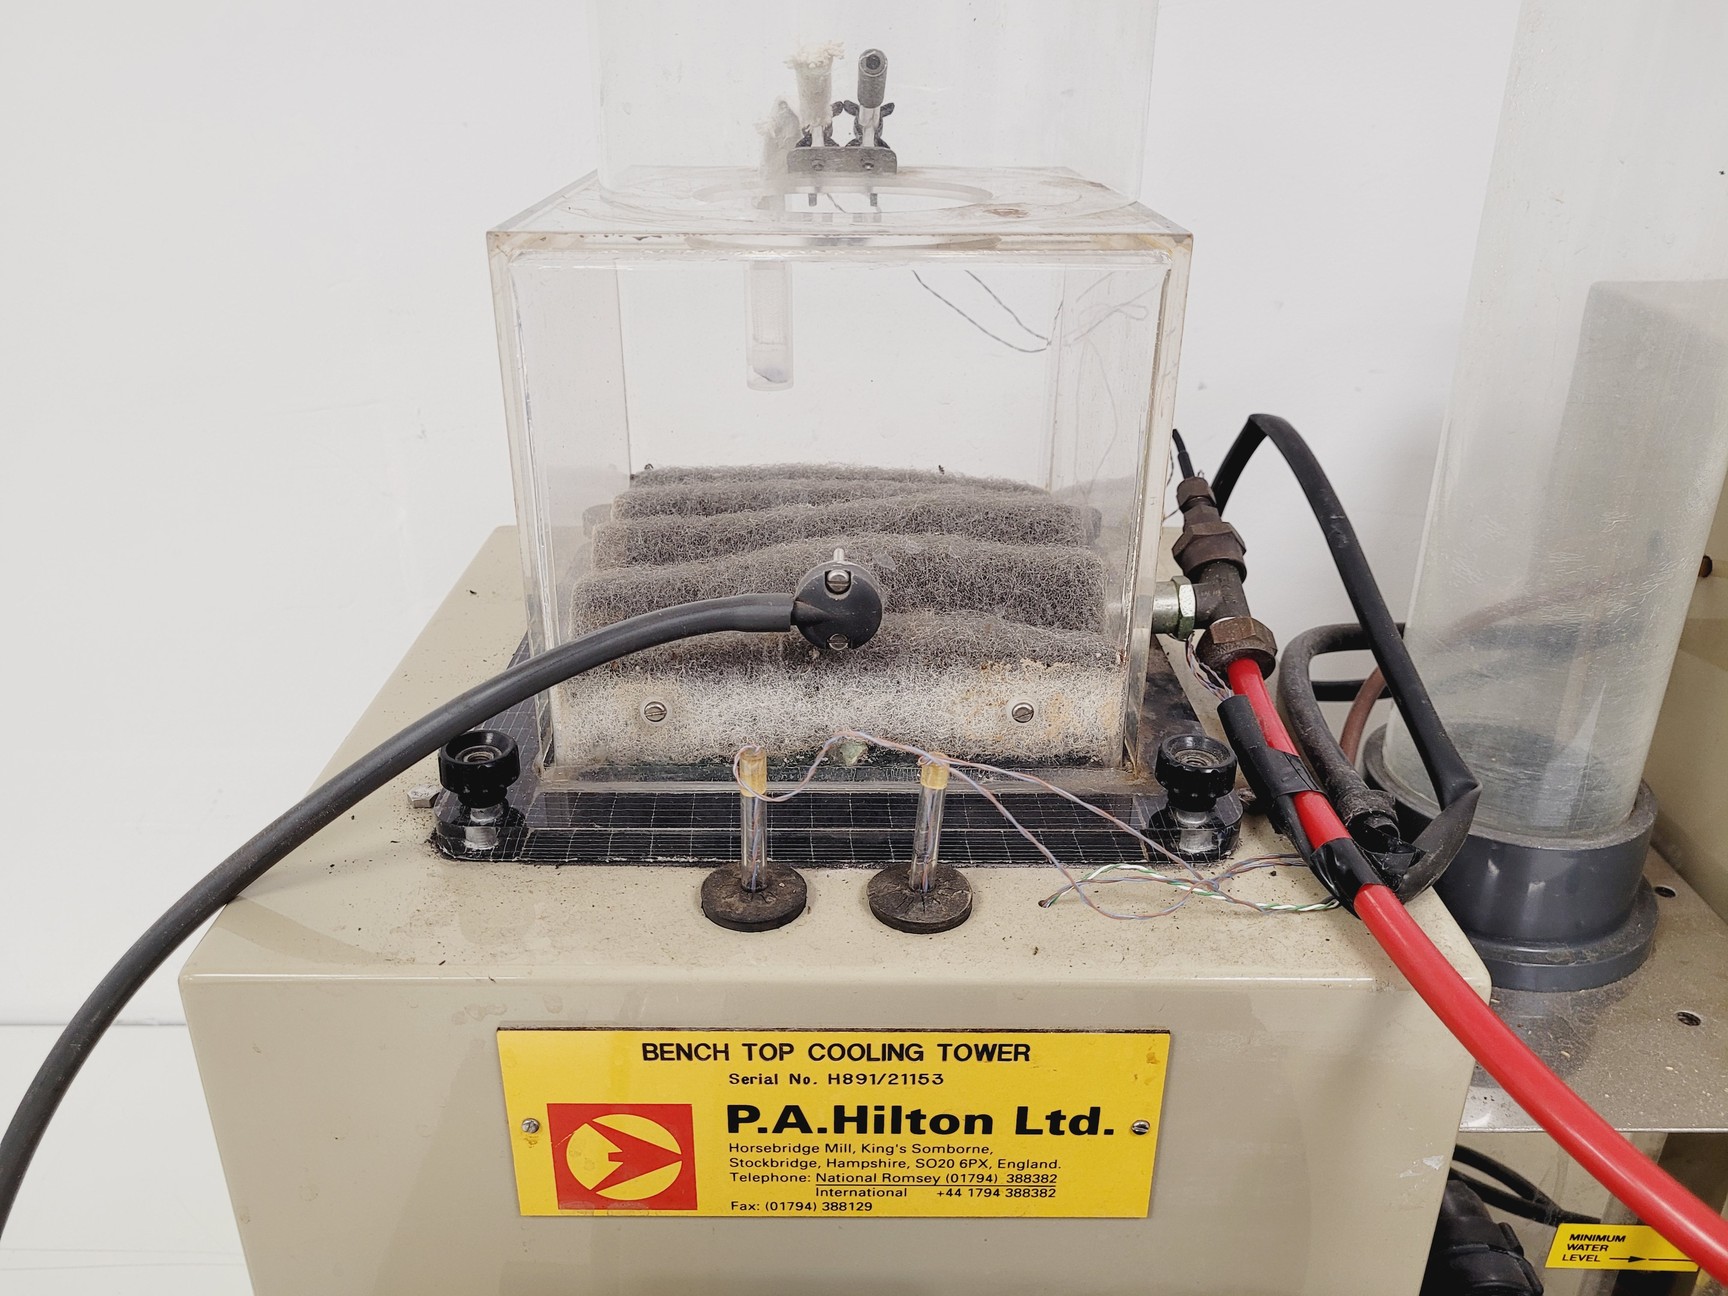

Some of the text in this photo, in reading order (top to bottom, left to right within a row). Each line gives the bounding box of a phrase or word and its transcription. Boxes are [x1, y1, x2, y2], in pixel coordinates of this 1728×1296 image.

[642, 1043, 1030, 1062] BENCH TOP COOLING TOWER
[729, 1073, 943, 1085] Serial No. H891/21153
[727, 1105, 1114, 1135] P.A.Hilton Ltd.
[729, 1143, 993, 1155] Horsebridge Mill, King's Somborne,
[730, 1158, 1061, 1171] Stockbridge, Hampshire, SO20 6PX, England.
[730, 1173, 1057, 1184] Telephone: National Romsey (01794) 388382
[816, 1188, 1056, 1198] International +44 1794 388382
[731, 1201, 872, 1211] Fax: (01794) 388129
[1569, 1234, 1626, 1243] MINIMUM
[1567, 1244, 1609, 1252] WATER
[1562, 1254, 1600, 1262] LEVEL
